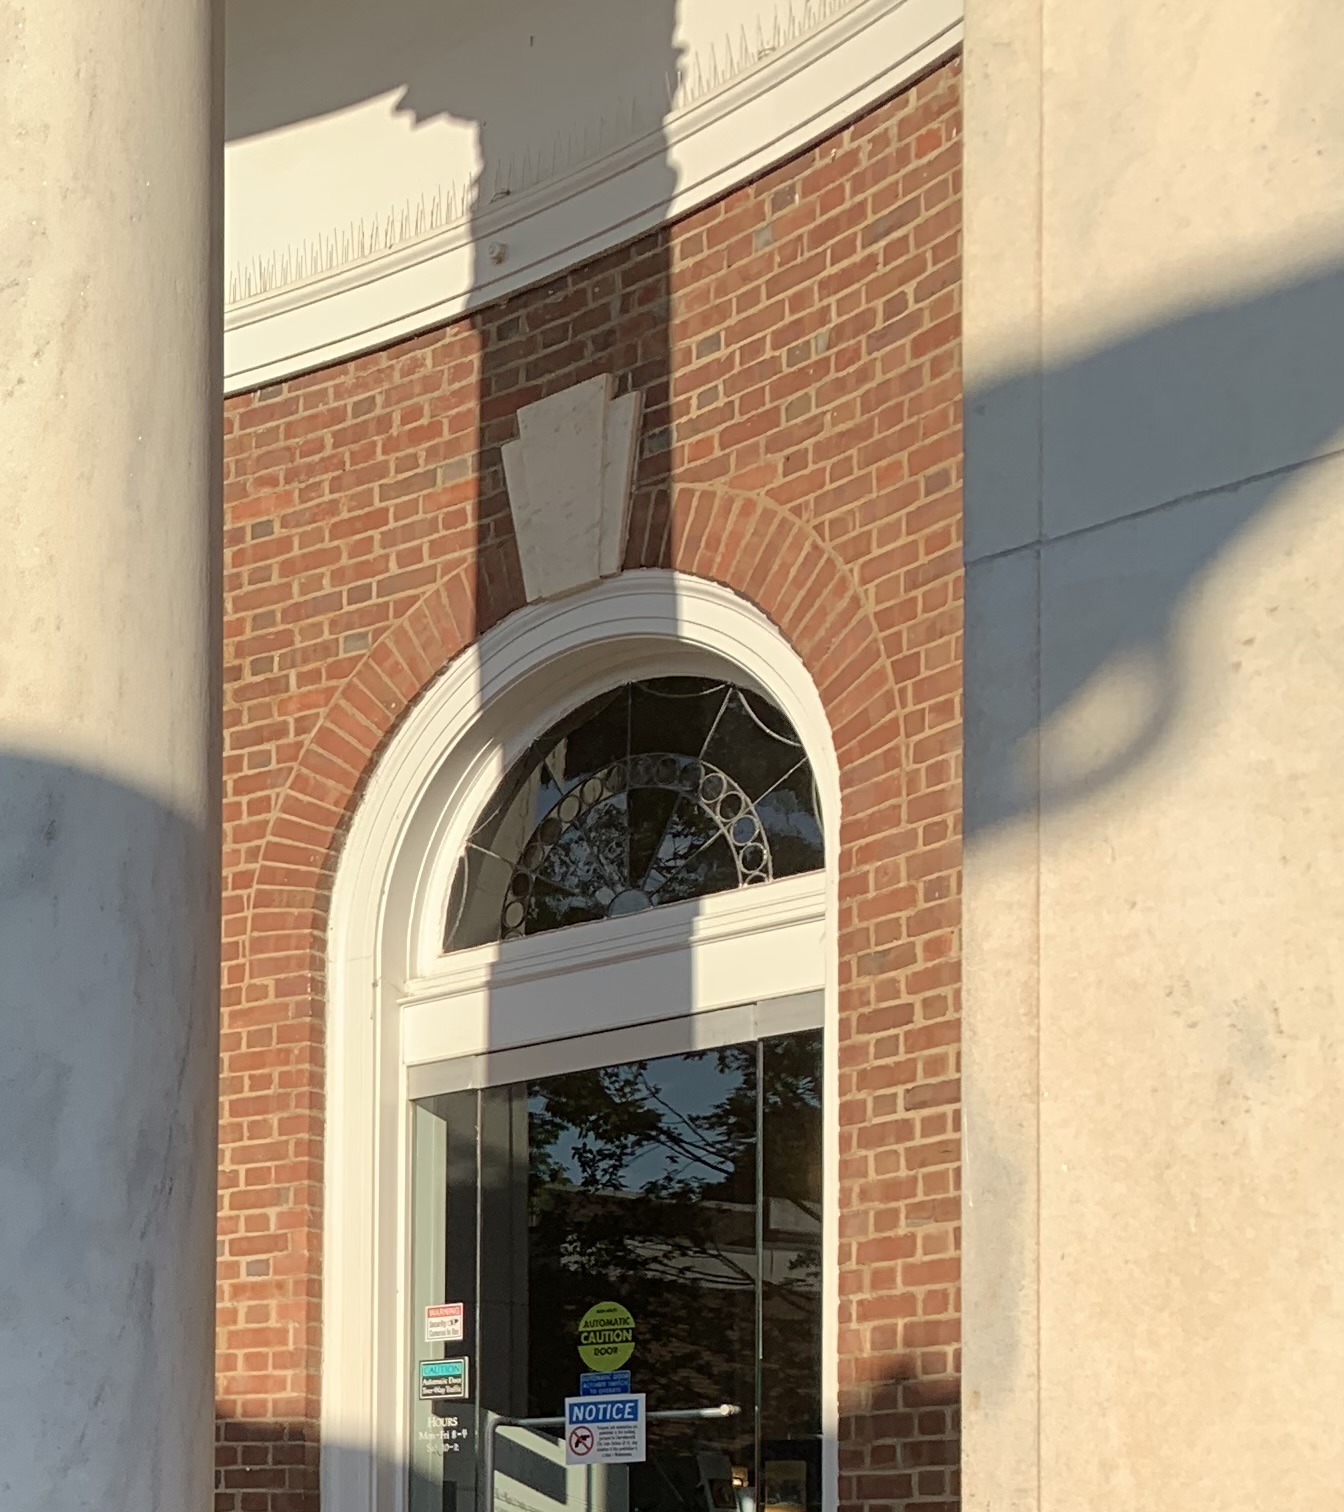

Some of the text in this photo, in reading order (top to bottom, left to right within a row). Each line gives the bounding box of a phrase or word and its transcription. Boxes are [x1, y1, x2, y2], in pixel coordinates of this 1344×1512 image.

[583, 1317, 630, 1328] AUTOMATIC
[580, 1329, 632, 1344] CAUTION
[593, 1347, 618, 1356] DOOR
[423, 1364, 461, 1375] CAUTION
[572, 1403, 635, 1421] NOTICE
[427, 1416, 458, 1427] HOURS
